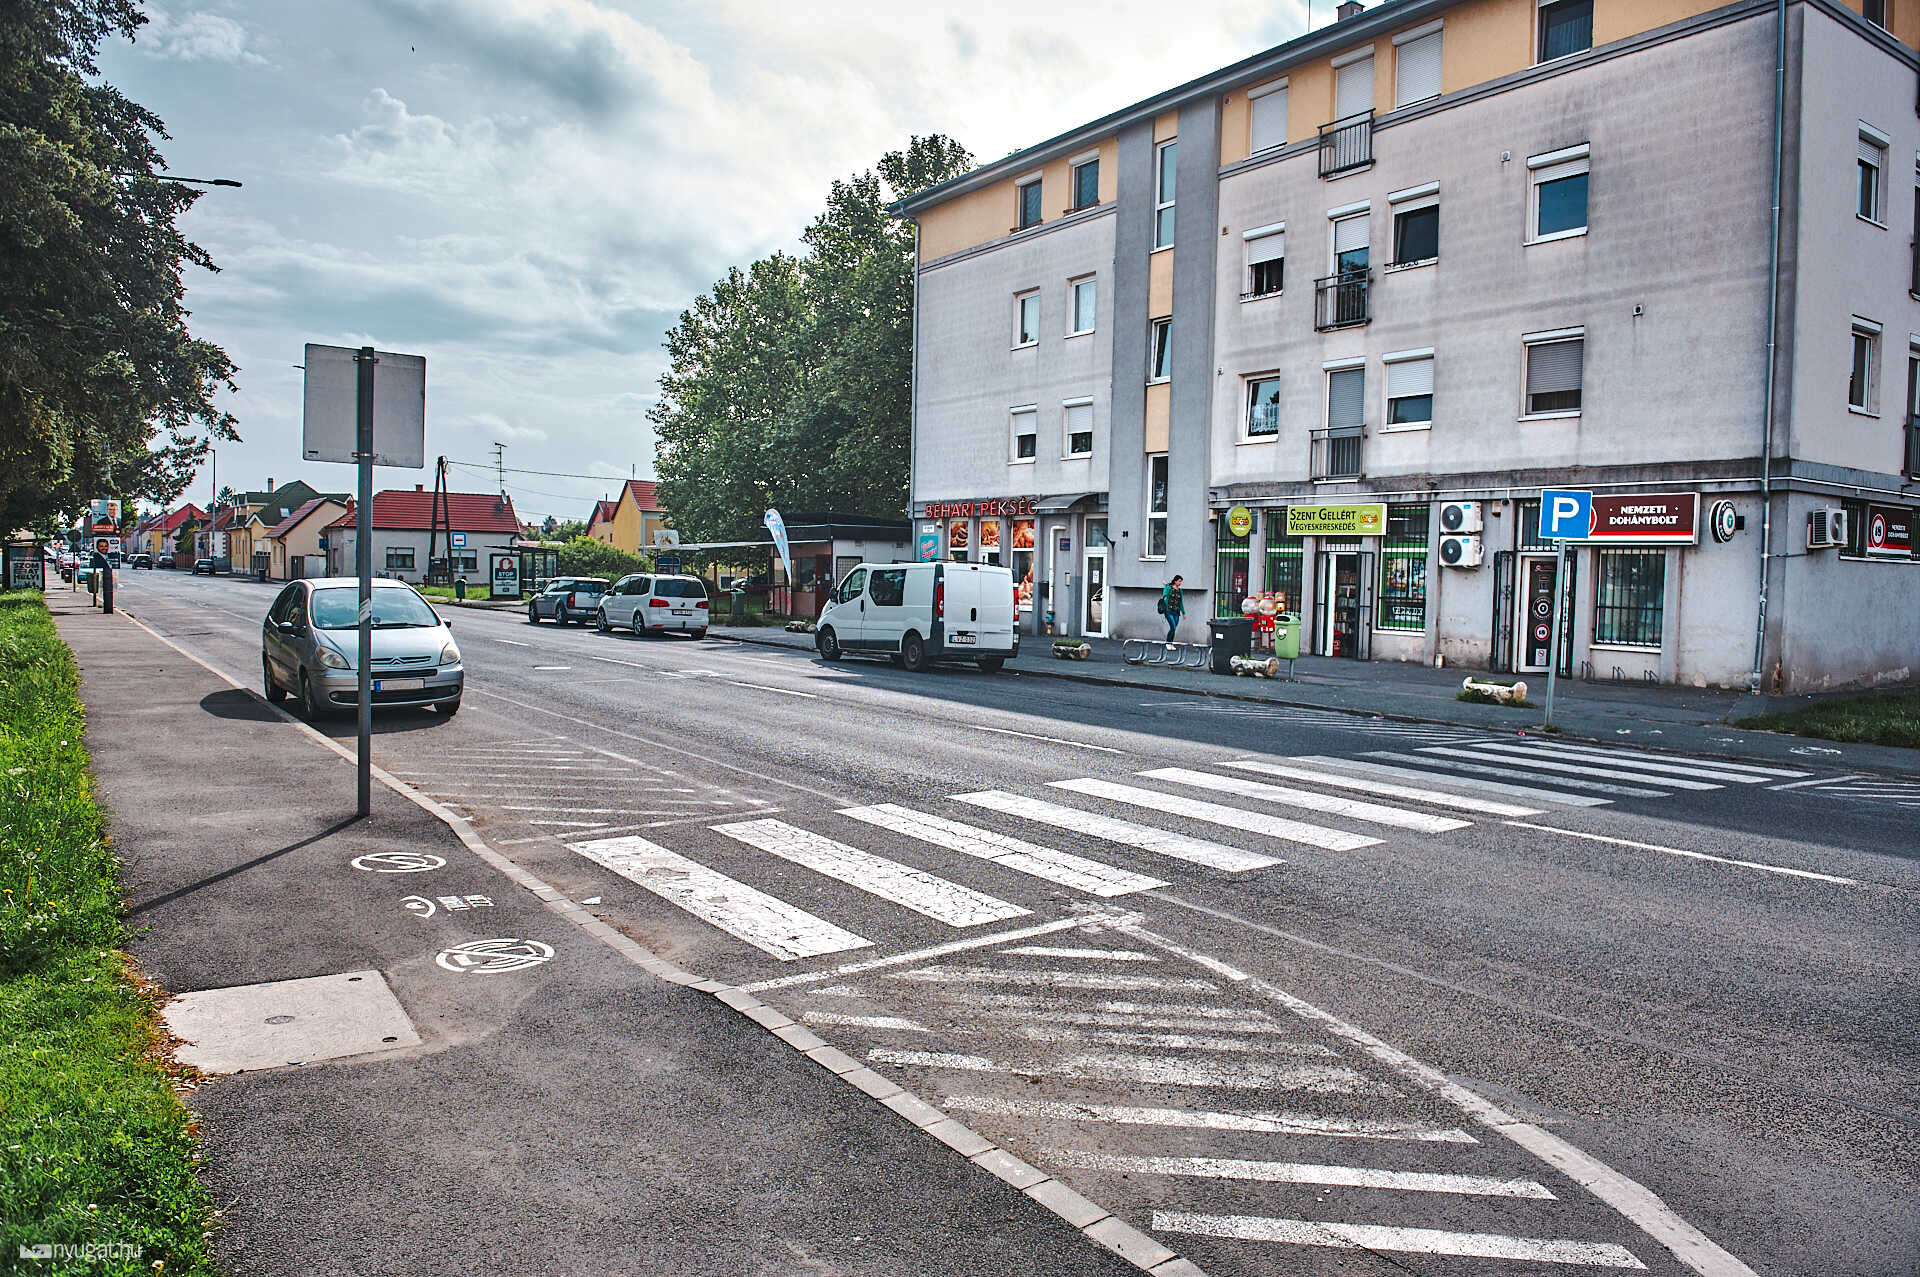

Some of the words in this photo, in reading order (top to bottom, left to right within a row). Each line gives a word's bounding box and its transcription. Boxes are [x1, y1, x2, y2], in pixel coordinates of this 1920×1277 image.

[925, 503, 975, 519] BEHARI
[979, 496, 1038, 516] PÉKSÉG
[1289, 508, 1316, 521] SZENT
[1318, 507, 1357, 521] GELLÉRT
[1552, 497, 1580, 532] P
[1620, 505, 1667, 515] NEMZETI
[1609, 514, 1679, 525] DOHÁNYBOLT
